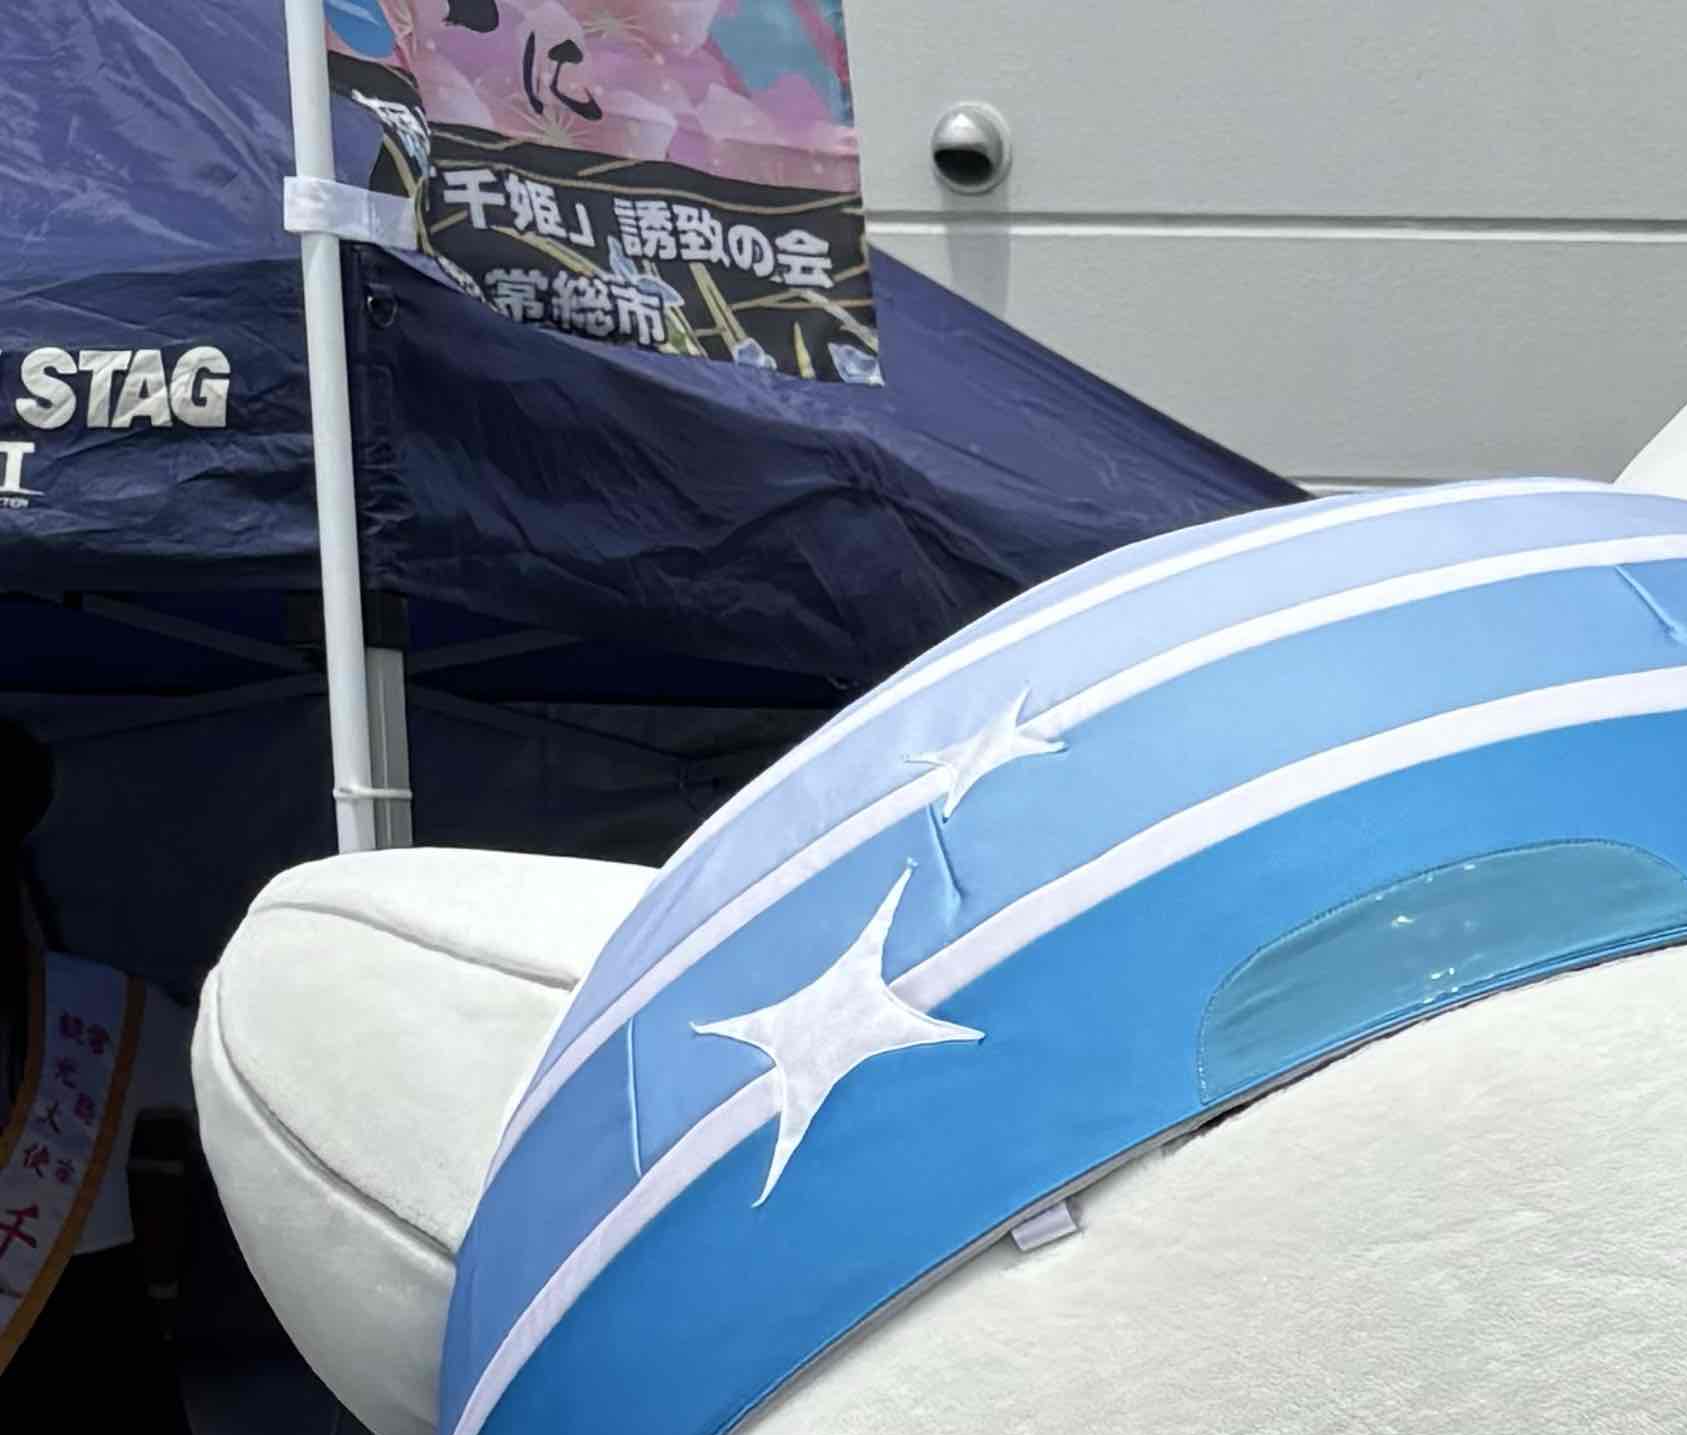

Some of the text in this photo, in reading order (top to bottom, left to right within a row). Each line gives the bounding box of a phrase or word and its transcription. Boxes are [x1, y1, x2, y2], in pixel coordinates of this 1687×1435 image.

[428, 168, 834, 288] 千姫」誘致の会
[484, 267, 667, 346] 常総市
[16, 346, 230, 428] STAG
